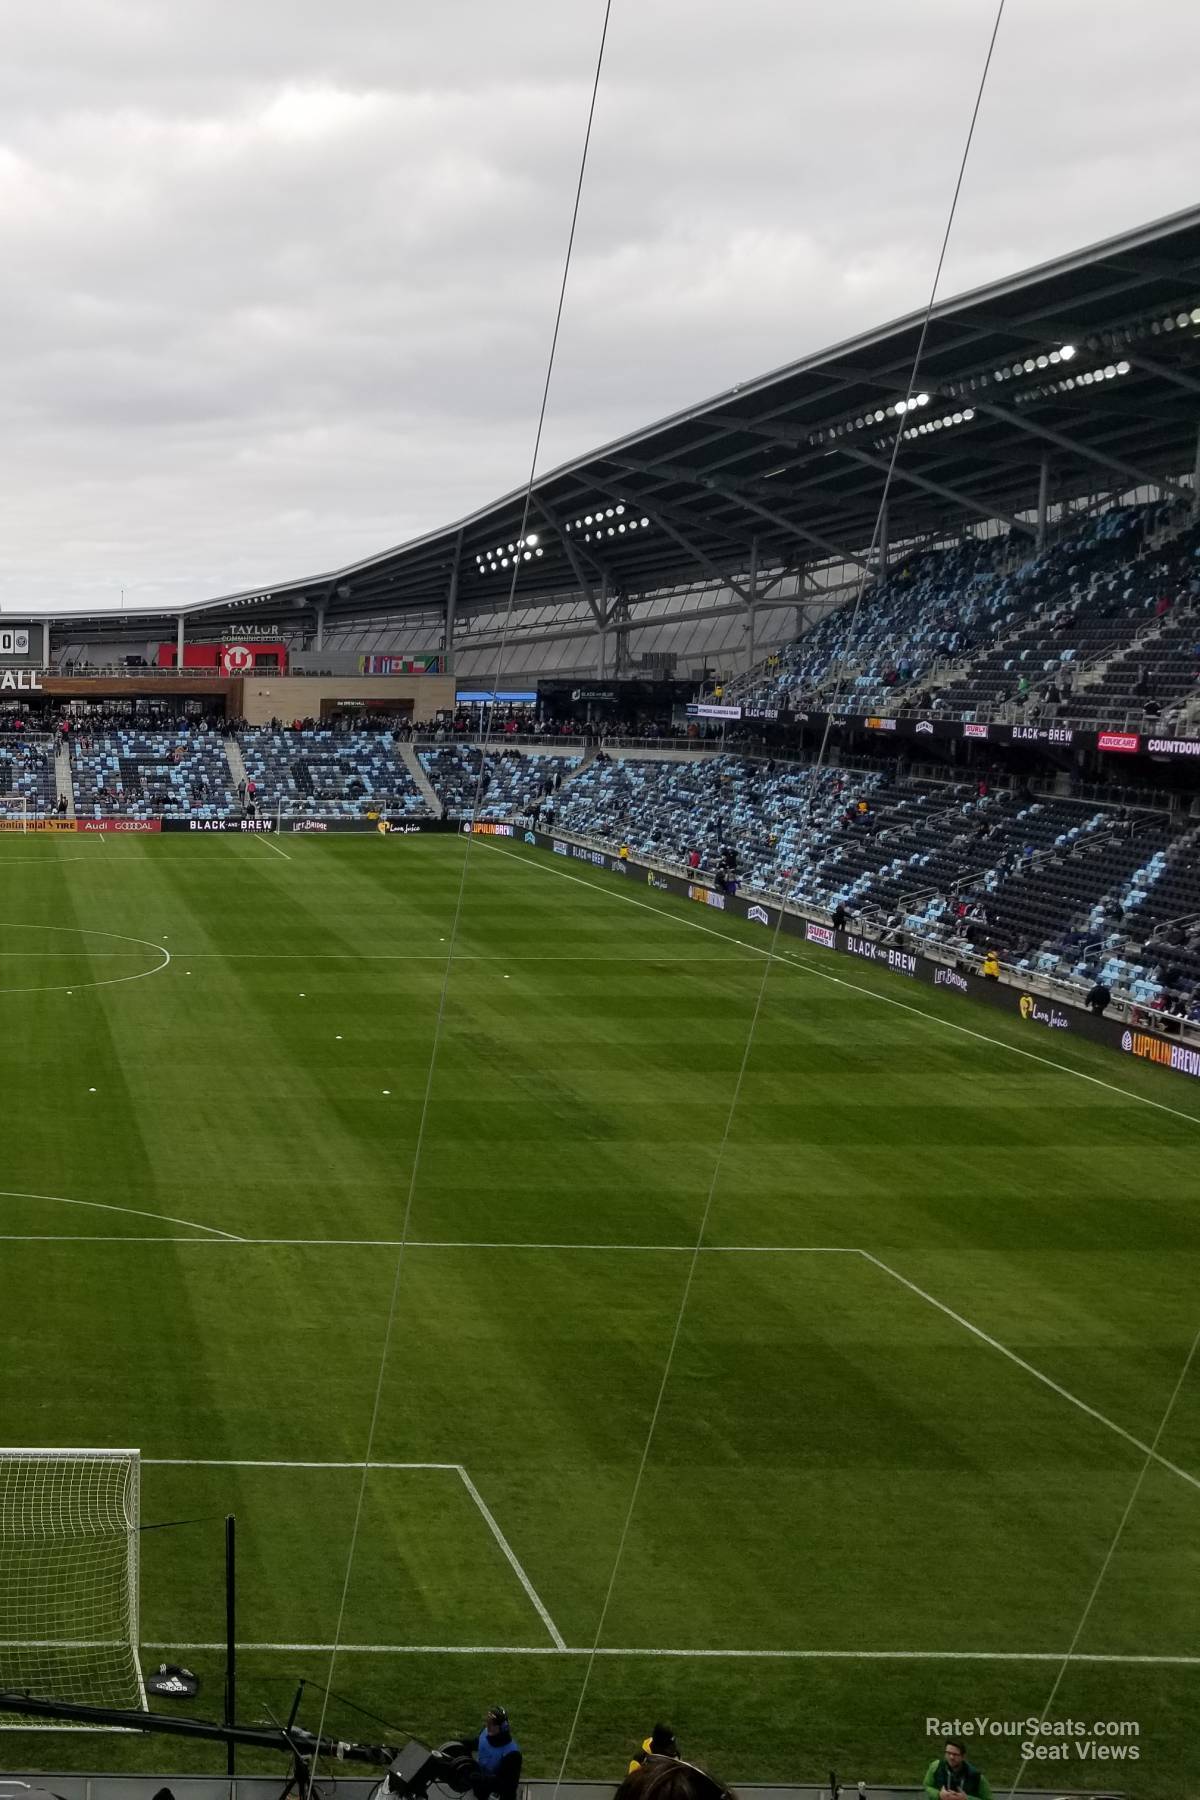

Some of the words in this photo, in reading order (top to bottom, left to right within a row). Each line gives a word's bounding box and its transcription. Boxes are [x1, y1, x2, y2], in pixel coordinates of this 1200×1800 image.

[230, 625, 279, 635] TAYLOR
[1013, 727, 1038, 739] BLACK
[1049, 728, 1072, 742] BREW
[85, 822, 108, 830] Audi
[190, 820, 226, 830] BLACK
[240, 820, 272, 830] BREW
[808, 925, 833, 941] SURLY
[847, 937, 876, 959] BLACK
[888, 950, 917, 972] BREW
[1032, 1004, 1048, 1022] Loon
[1048, 1009, 1068, 1027] Juice
[1133, 1032, 1172, 1066] LUPULIN
